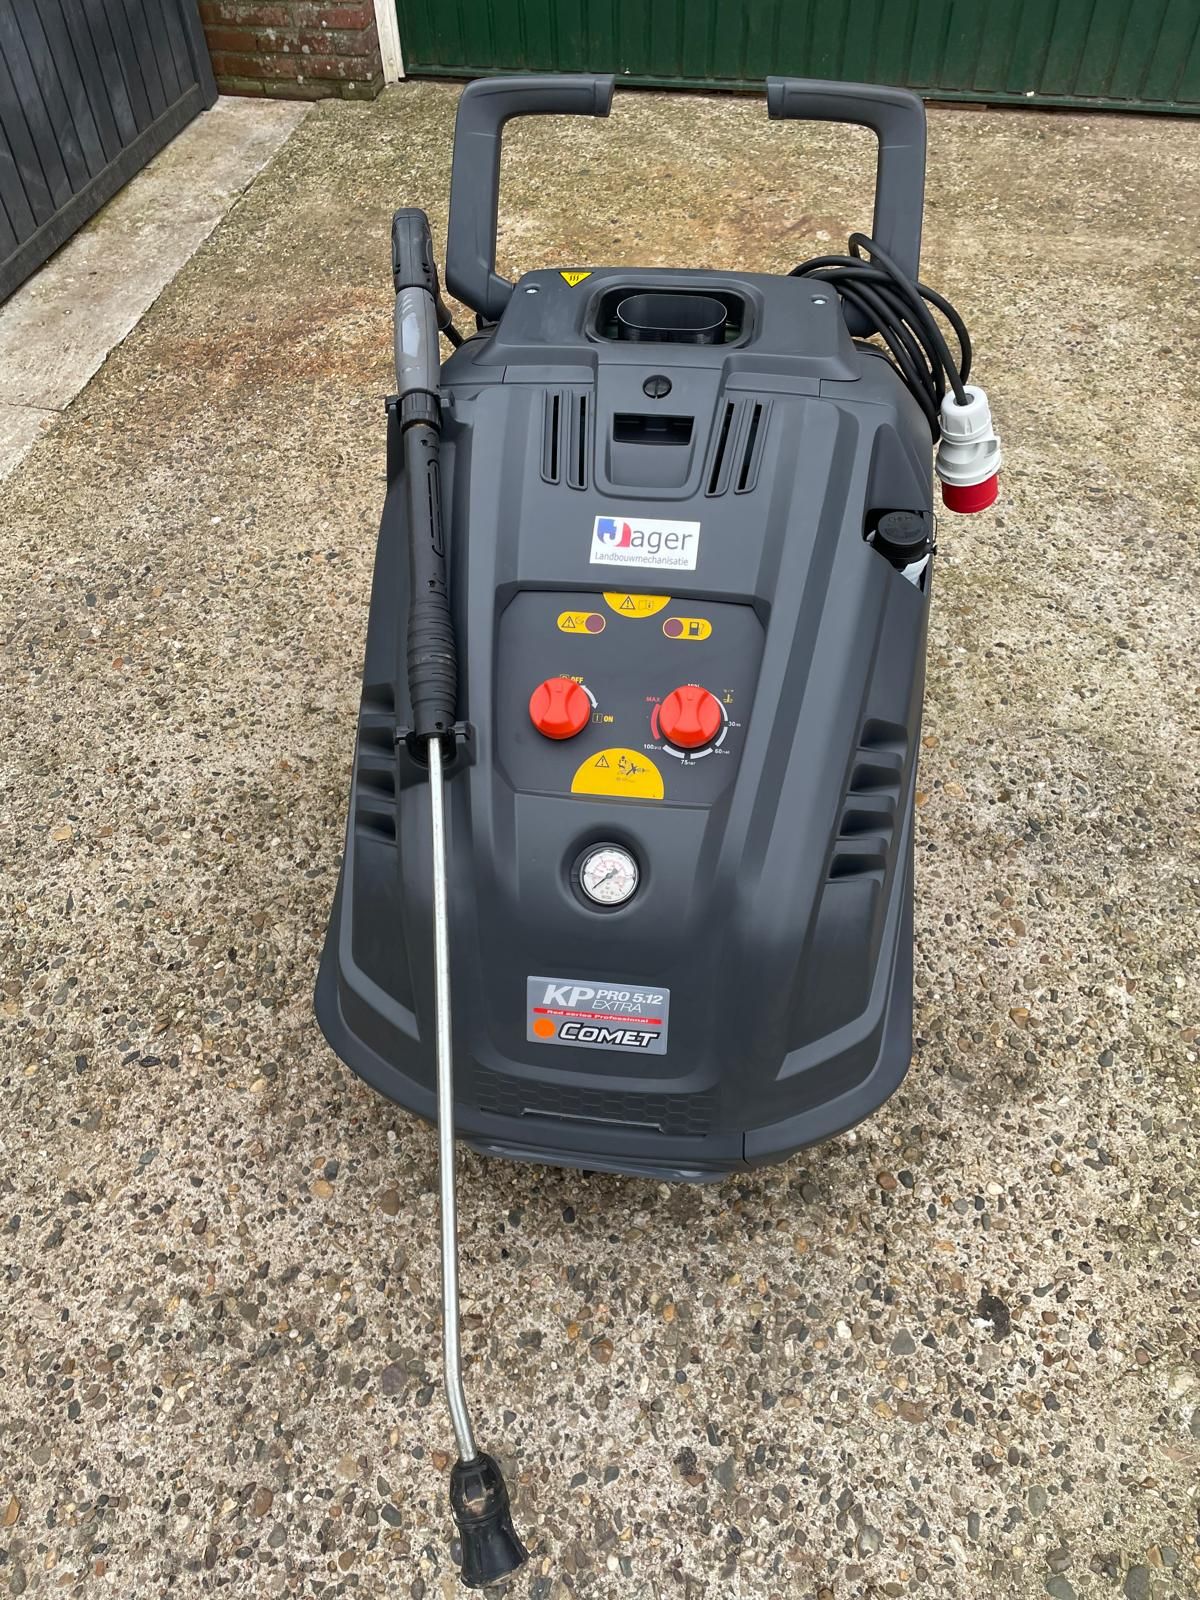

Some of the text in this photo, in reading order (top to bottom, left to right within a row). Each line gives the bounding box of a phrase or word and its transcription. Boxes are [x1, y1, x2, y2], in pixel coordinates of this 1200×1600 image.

[594, 552, 688, 566] Landbouwmechanisatie
[570, 676, 584, 684] OFF
[603, 715, 614, 723] ON
[543, 984, 663, 1007] KP PRO 5.12
[592, 999, 641, 1013] EXTRA
[594, 1014, 649, 1024] Professional
[559, 1021, 661, 1047] COMET
